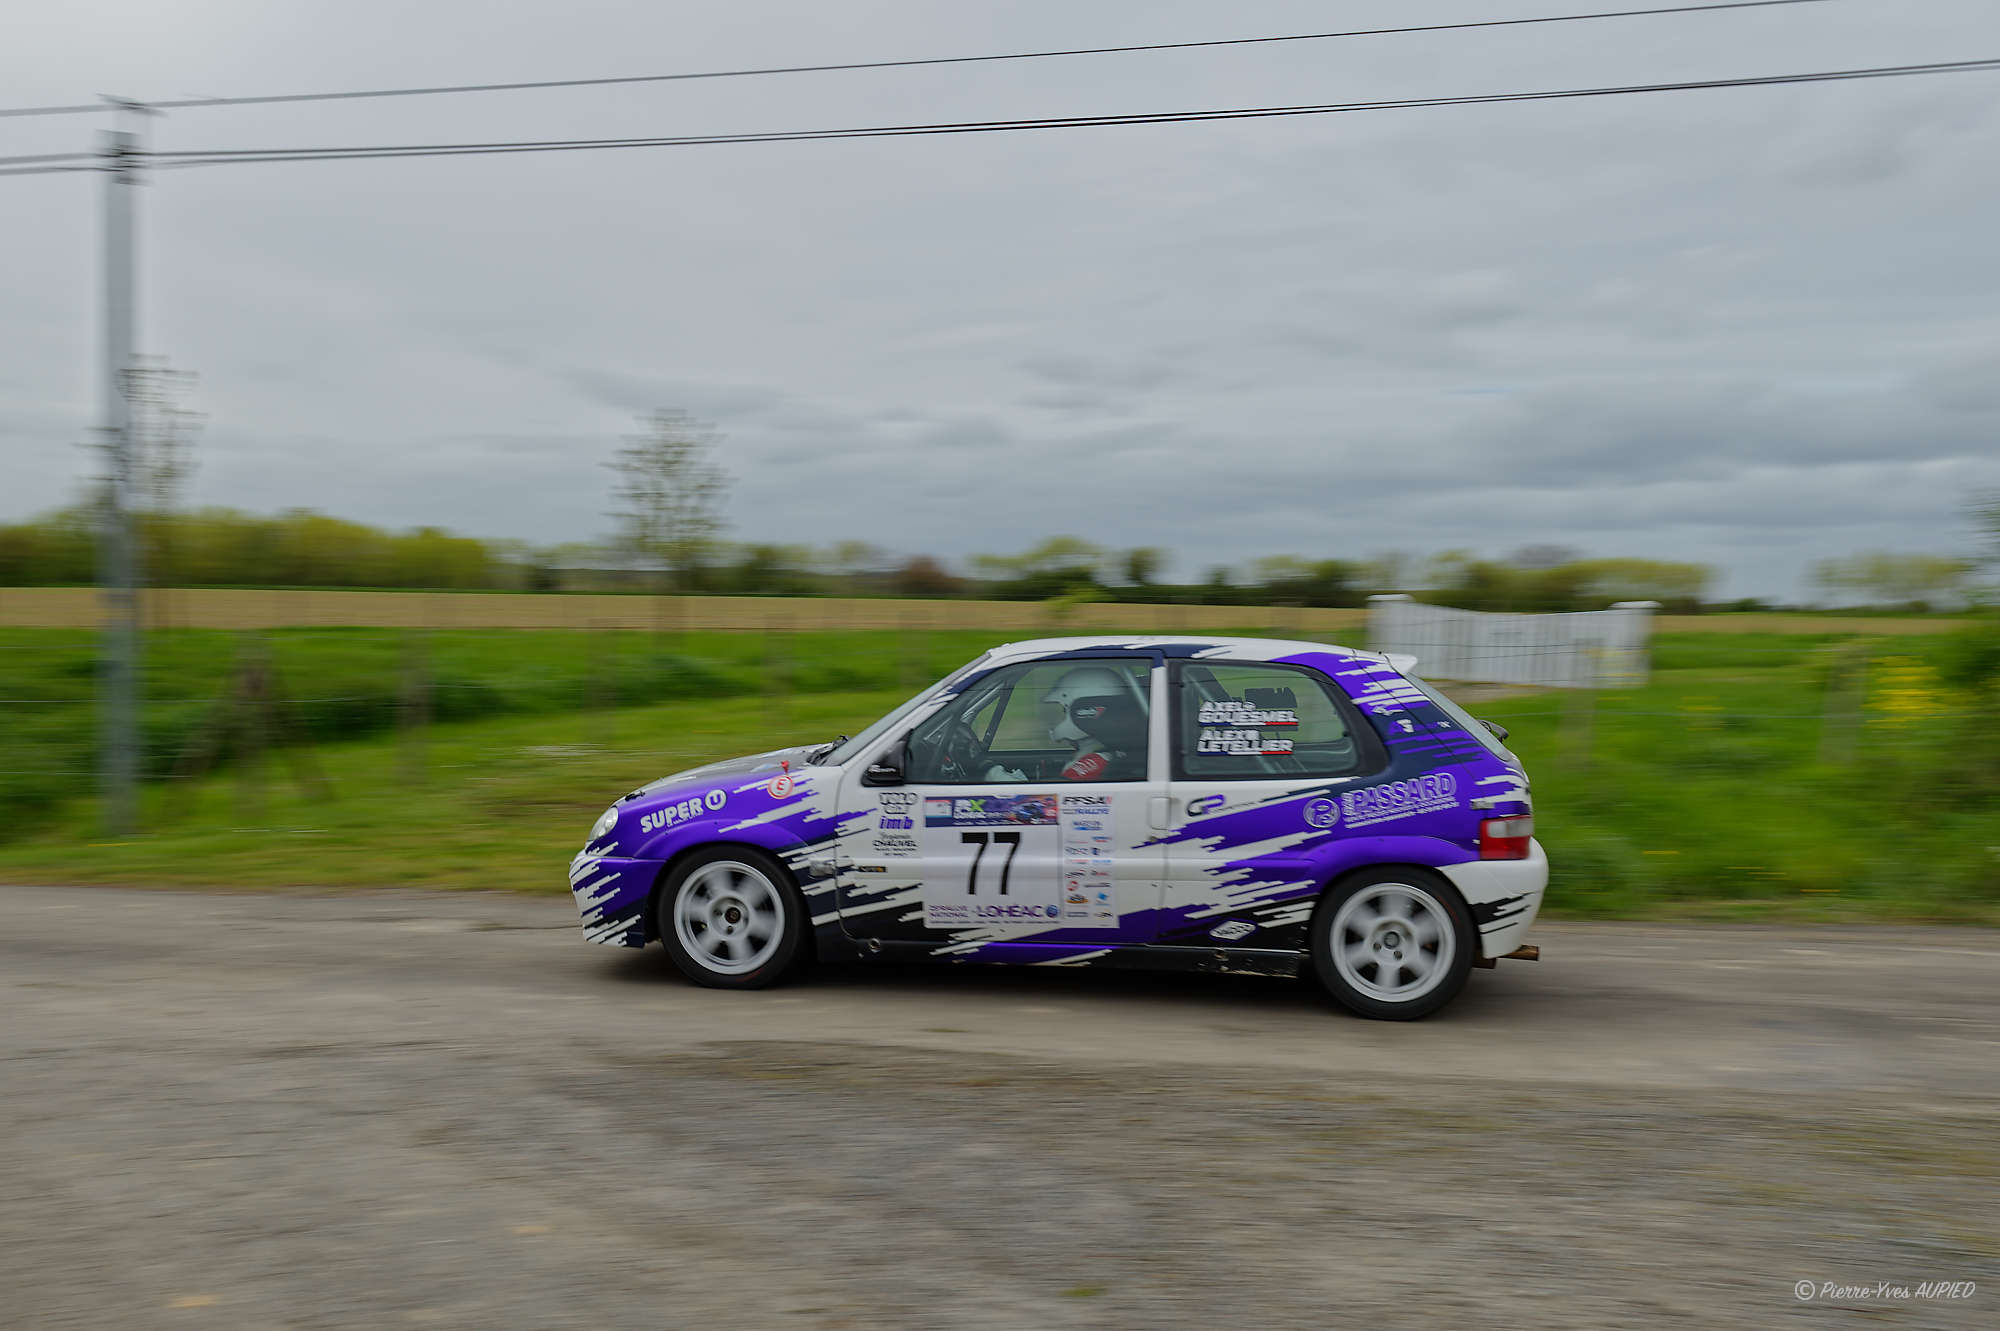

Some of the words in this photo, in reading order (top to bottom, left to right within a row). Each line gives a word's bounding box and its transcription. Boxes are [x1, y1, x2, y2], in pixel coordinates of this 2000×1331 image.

[1197, 740, 1294, 752] LETELLIER
[1349, 772, 1457, 812] PASSARD
[640, 797, 704, 834] SUPER
[961, 831, 1021, 896] 77
